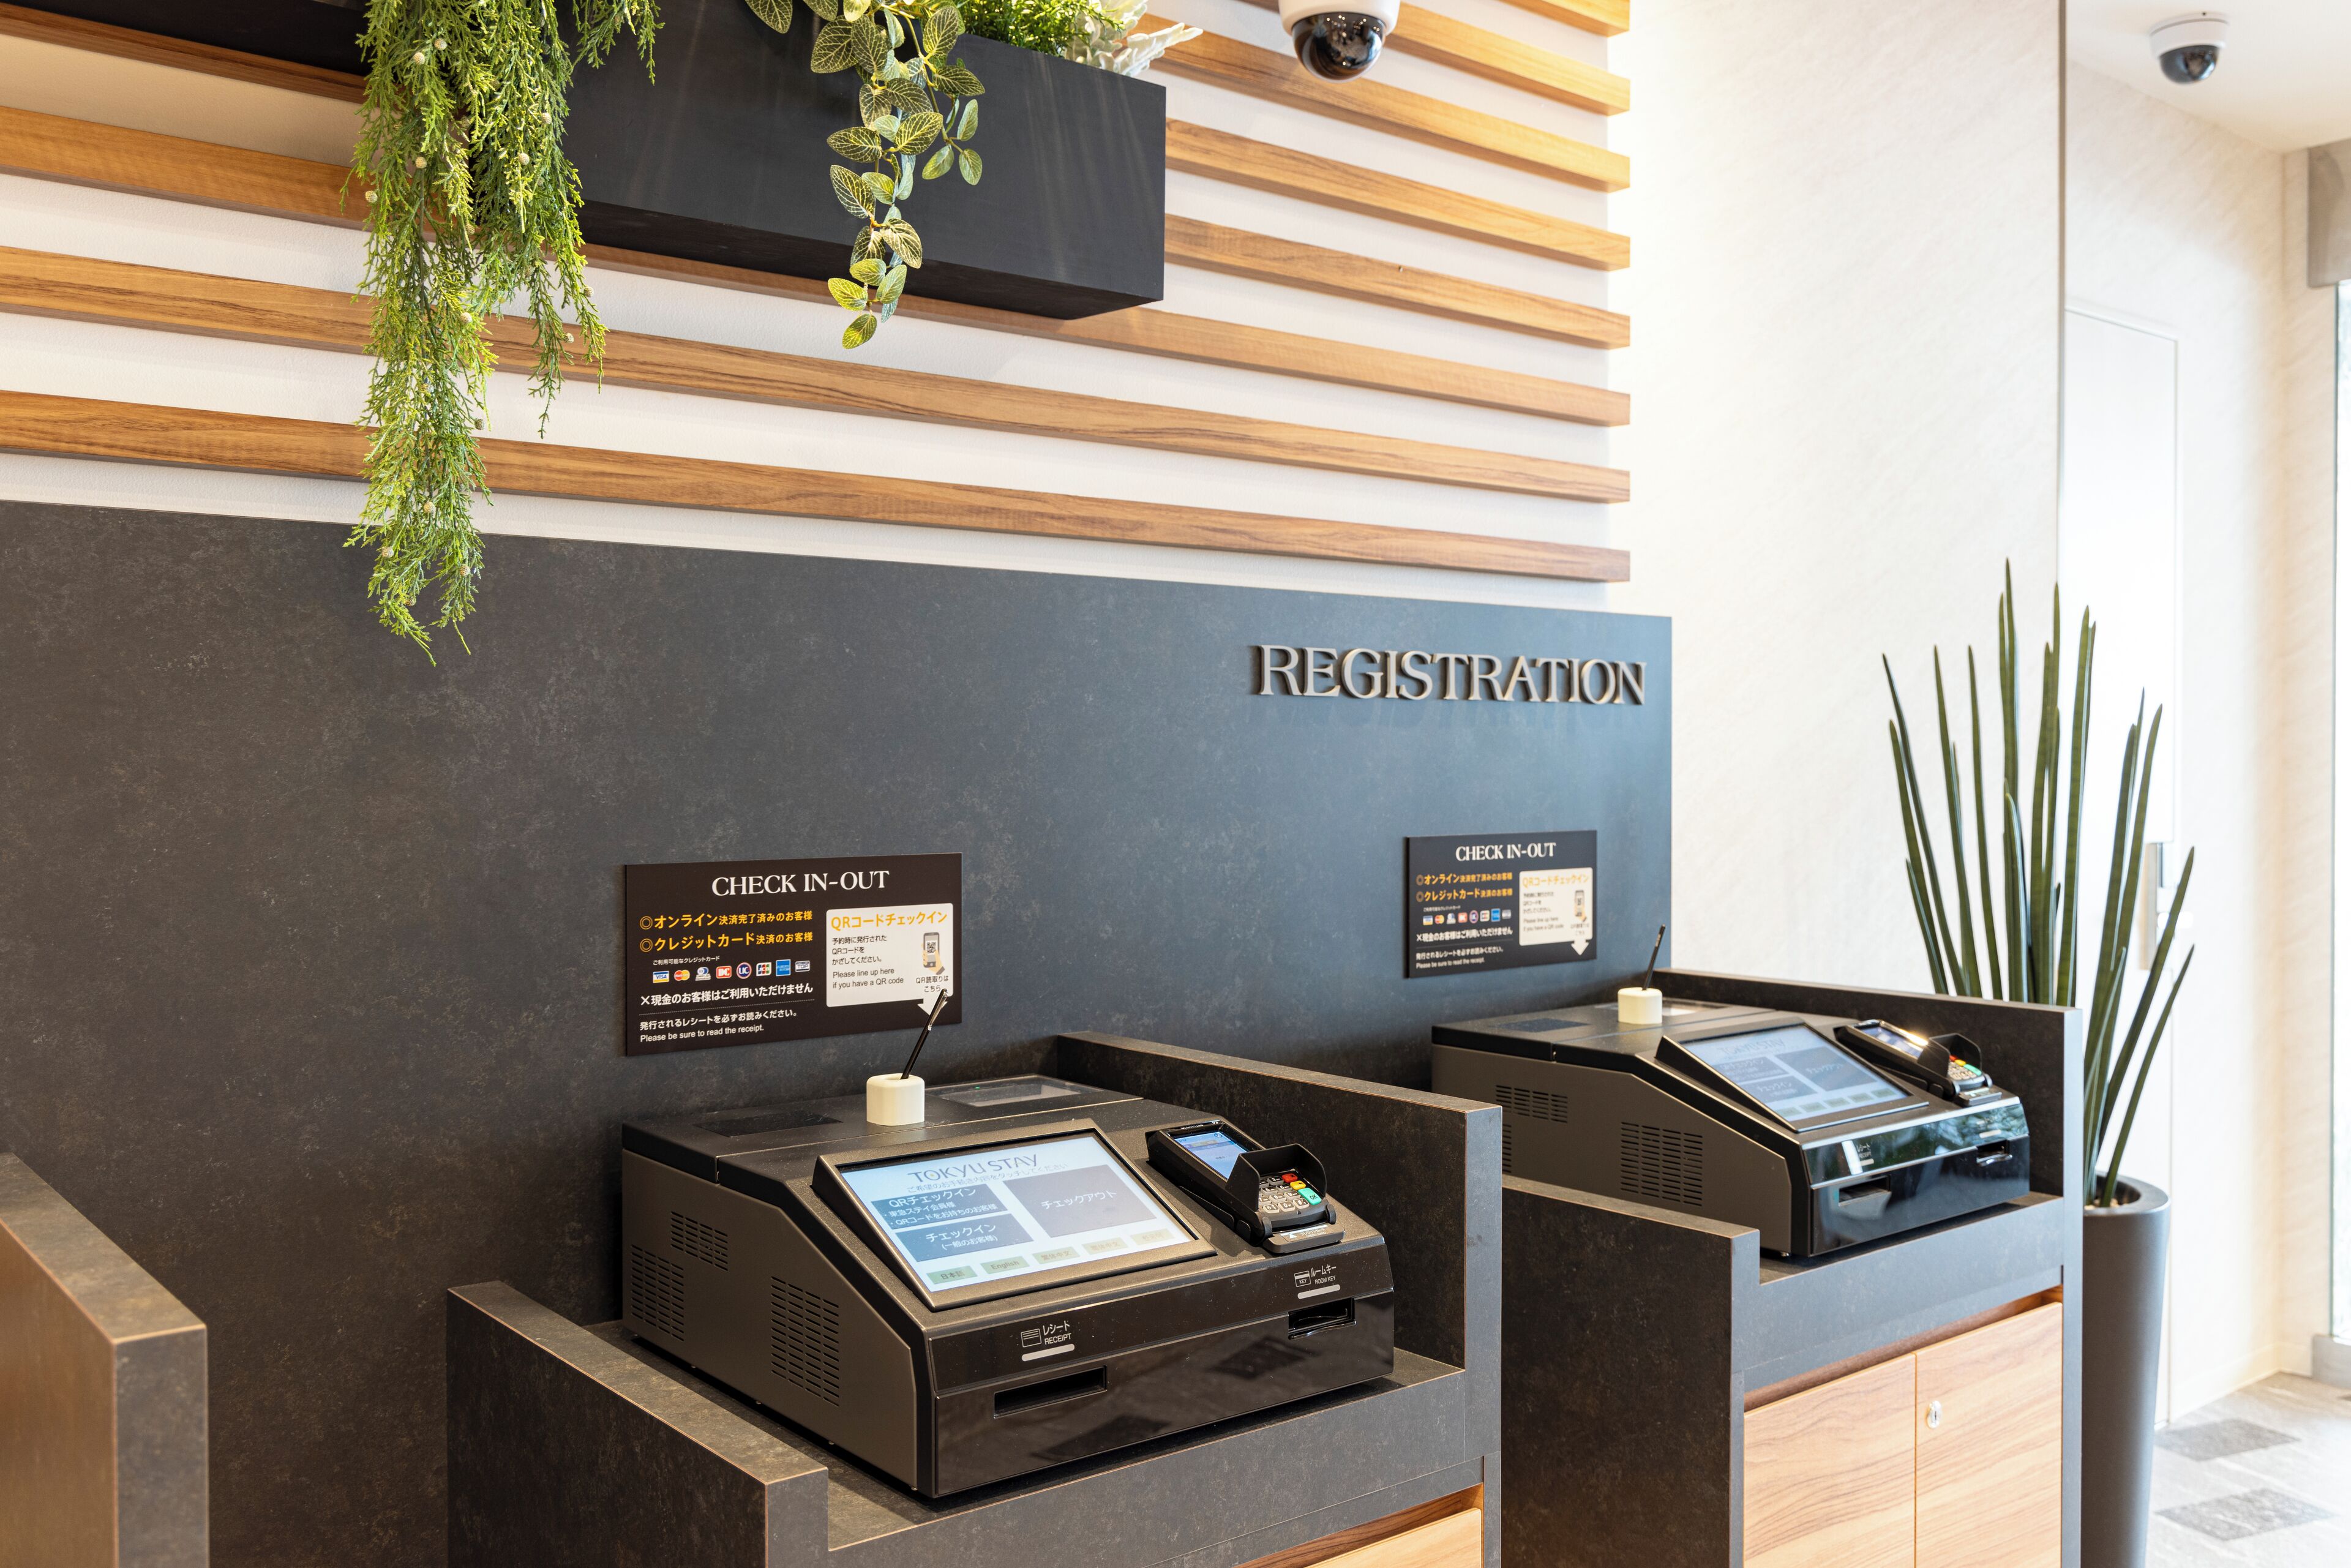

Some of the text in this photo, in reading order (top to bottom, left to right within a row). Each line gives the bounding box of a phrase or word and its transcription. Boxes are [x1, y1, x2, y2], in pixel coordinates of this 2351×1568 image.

[1258, 643, 1647, 706] REGISTRATION
[1455, 842, 1556, 861] CHECK IN-OUT
[712, 871, 890, 896] CHECK IN-OUT
[831, 911, 948, 931] QRコードチェックイン
[832, 935, 887, 945] 予約時に発行された
[832, 947, 865, 955] QRコードを
[653, 955, 720, 966] ご利用可能なクレジットカード
[832, 956, 882, 966] かざしてください。
[915, 975, 948, 985] QR読取りは
[924, 985, 941, 993] こちら
[640, 1008, 798, 1031] 発行されるレシートを必ずお読みください。
[640, 1032, 667, 1043] Please
[668, 1031, 678, 1040] be
[707, 1028, 723, 1037] read
[725, 1026, 737, 1035] the
[738, 1024, 765, 1035] receipt.
[907, 1154, 1037, 1182] TOKYU STAY
[888, 1188, 976, 1208] QRチェックイン
[1040, 1190, 1117, 1210] チェックアウト
[925, 1223, 996, 1242] チェックイン
[990, 1260, 1019, 1270] English
[1311, 1264, 1337, 1277] ルームキー
[940, 1270, 965, 1280] 日本語
[1043, 1320, 1070, 1335] レシート
[1044, 1333, 1071, 1345] RECEIPT
